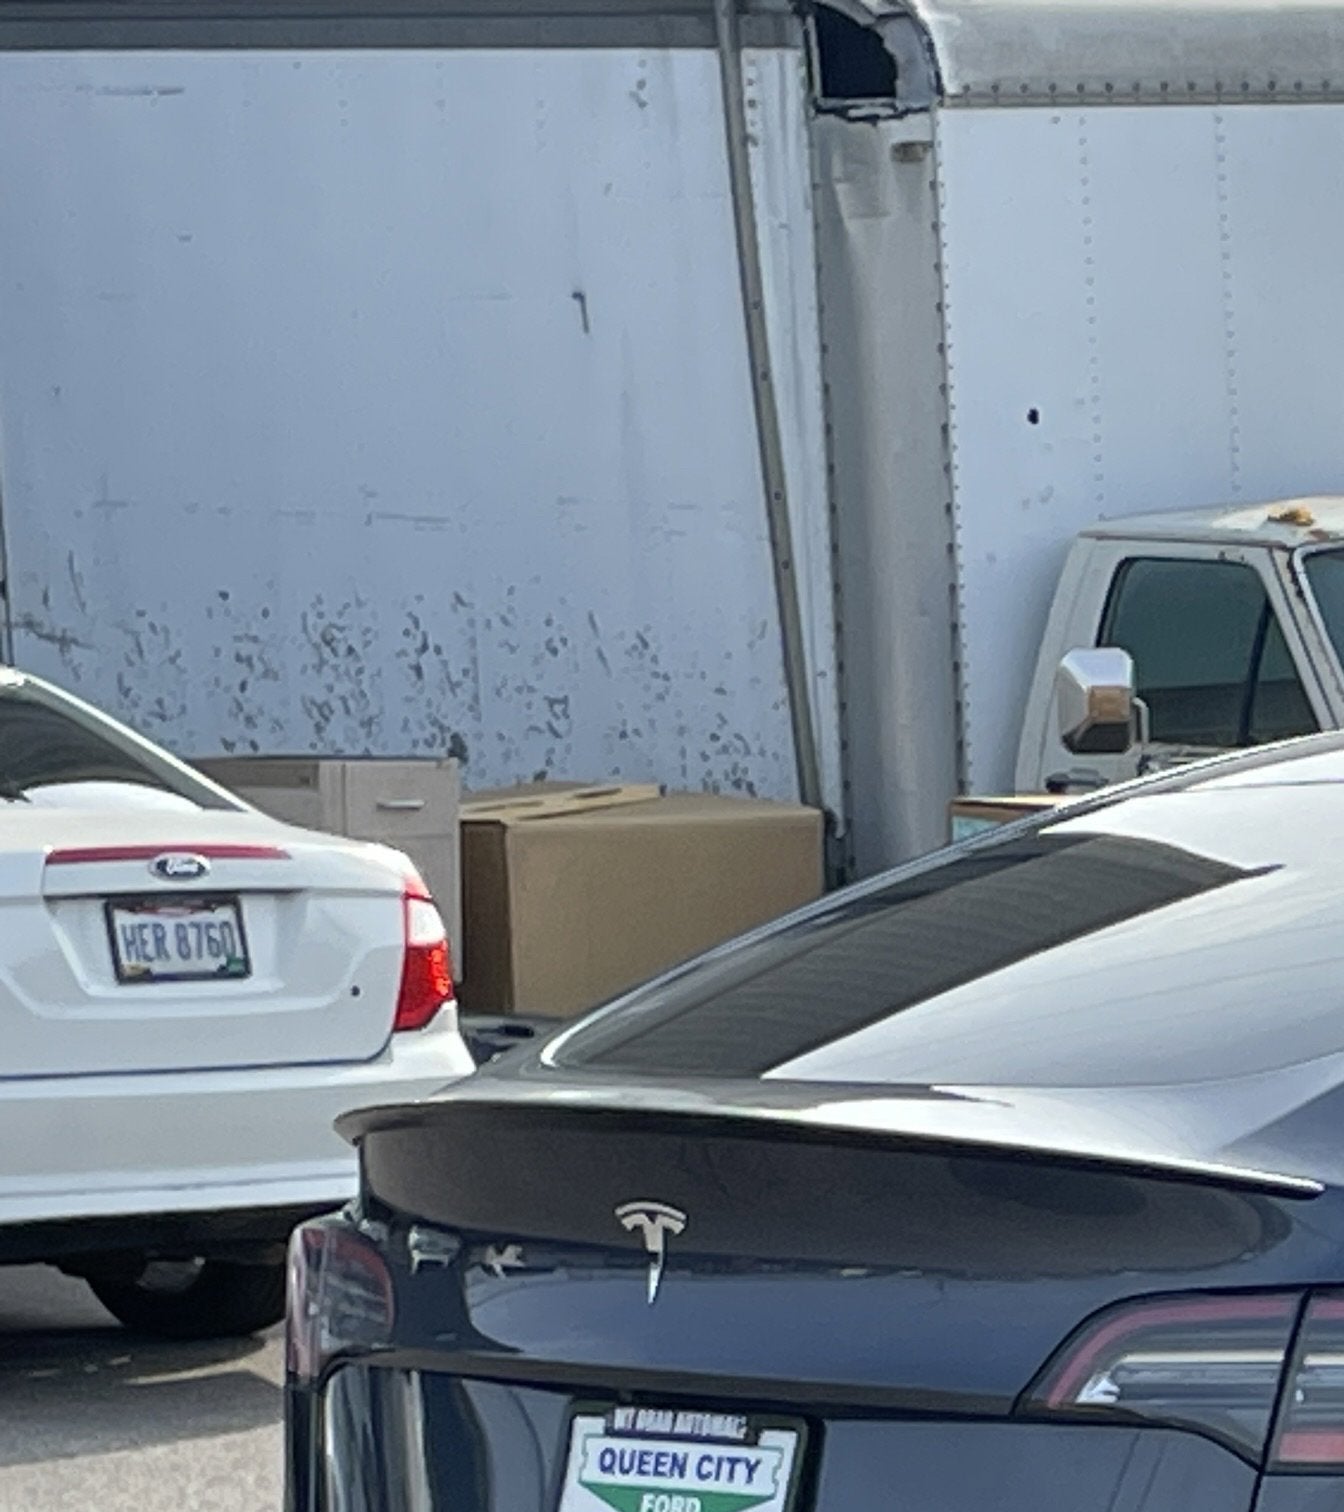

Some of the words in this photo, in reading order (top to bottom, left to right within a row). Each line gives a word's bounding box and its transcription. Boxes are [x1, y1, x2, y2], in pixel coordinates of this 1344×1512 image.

[121, 922, 171, 963] HER
[175, 921, 238, 961] 8760
[599, 1447, 690, 1480] QUEEN
[695, 1453, 762, 1485] CITY
